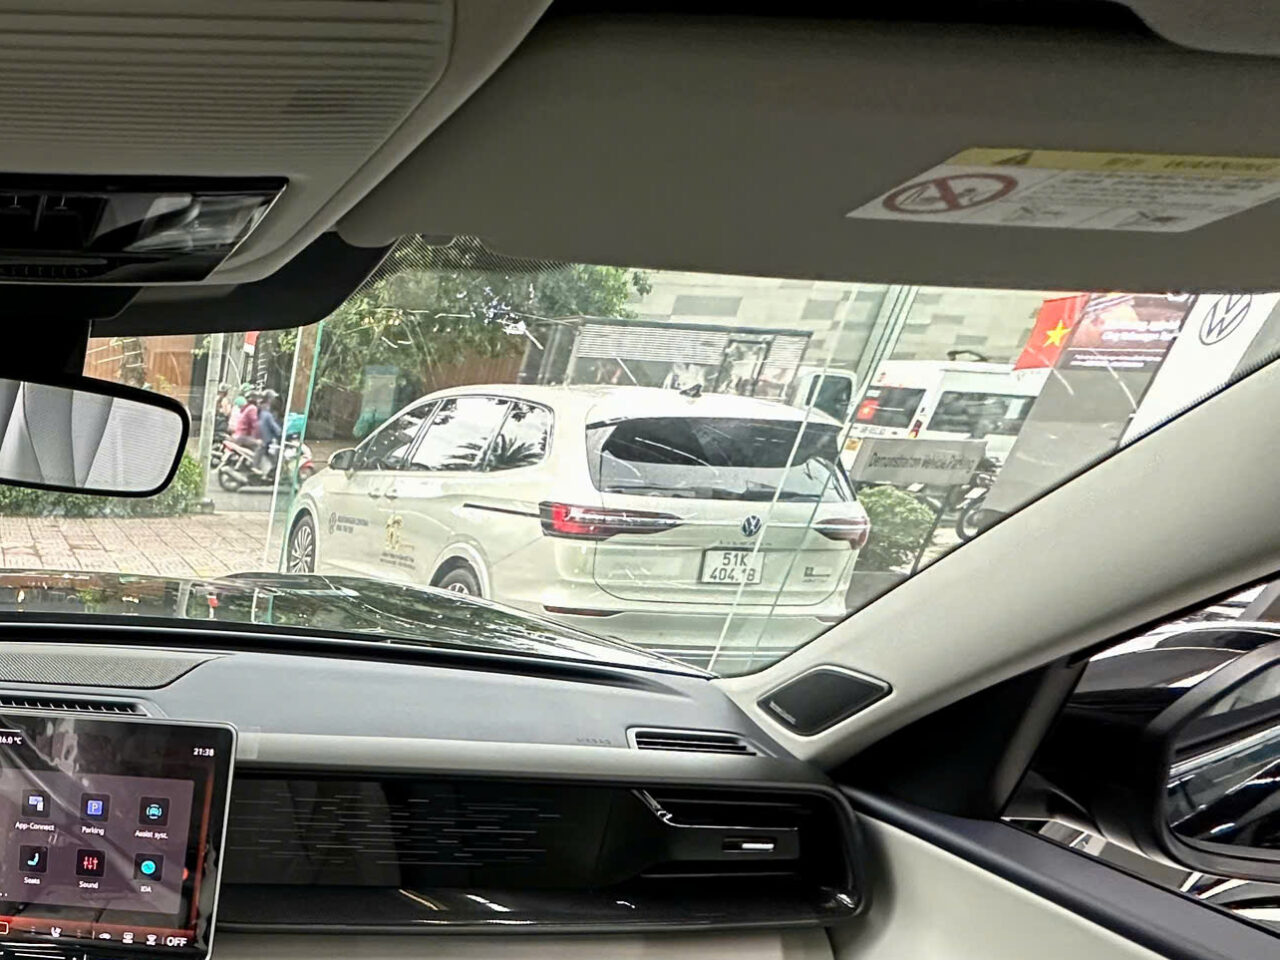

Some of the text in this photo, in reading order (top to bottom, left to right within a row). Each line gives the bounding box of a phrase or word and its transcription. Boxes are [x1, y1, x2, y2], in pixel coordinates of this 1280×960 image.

[722, 552, 749, 567] 51K
[15, 821, 55, 832] App-Connect
[81, 826, 105, 836] Parking
[134, 829, 153, 839] Assist
[24, 876, 41, 885] Seats
[79, 880, 99, 889] Sound
[166, 936, 187, 947] OFF
